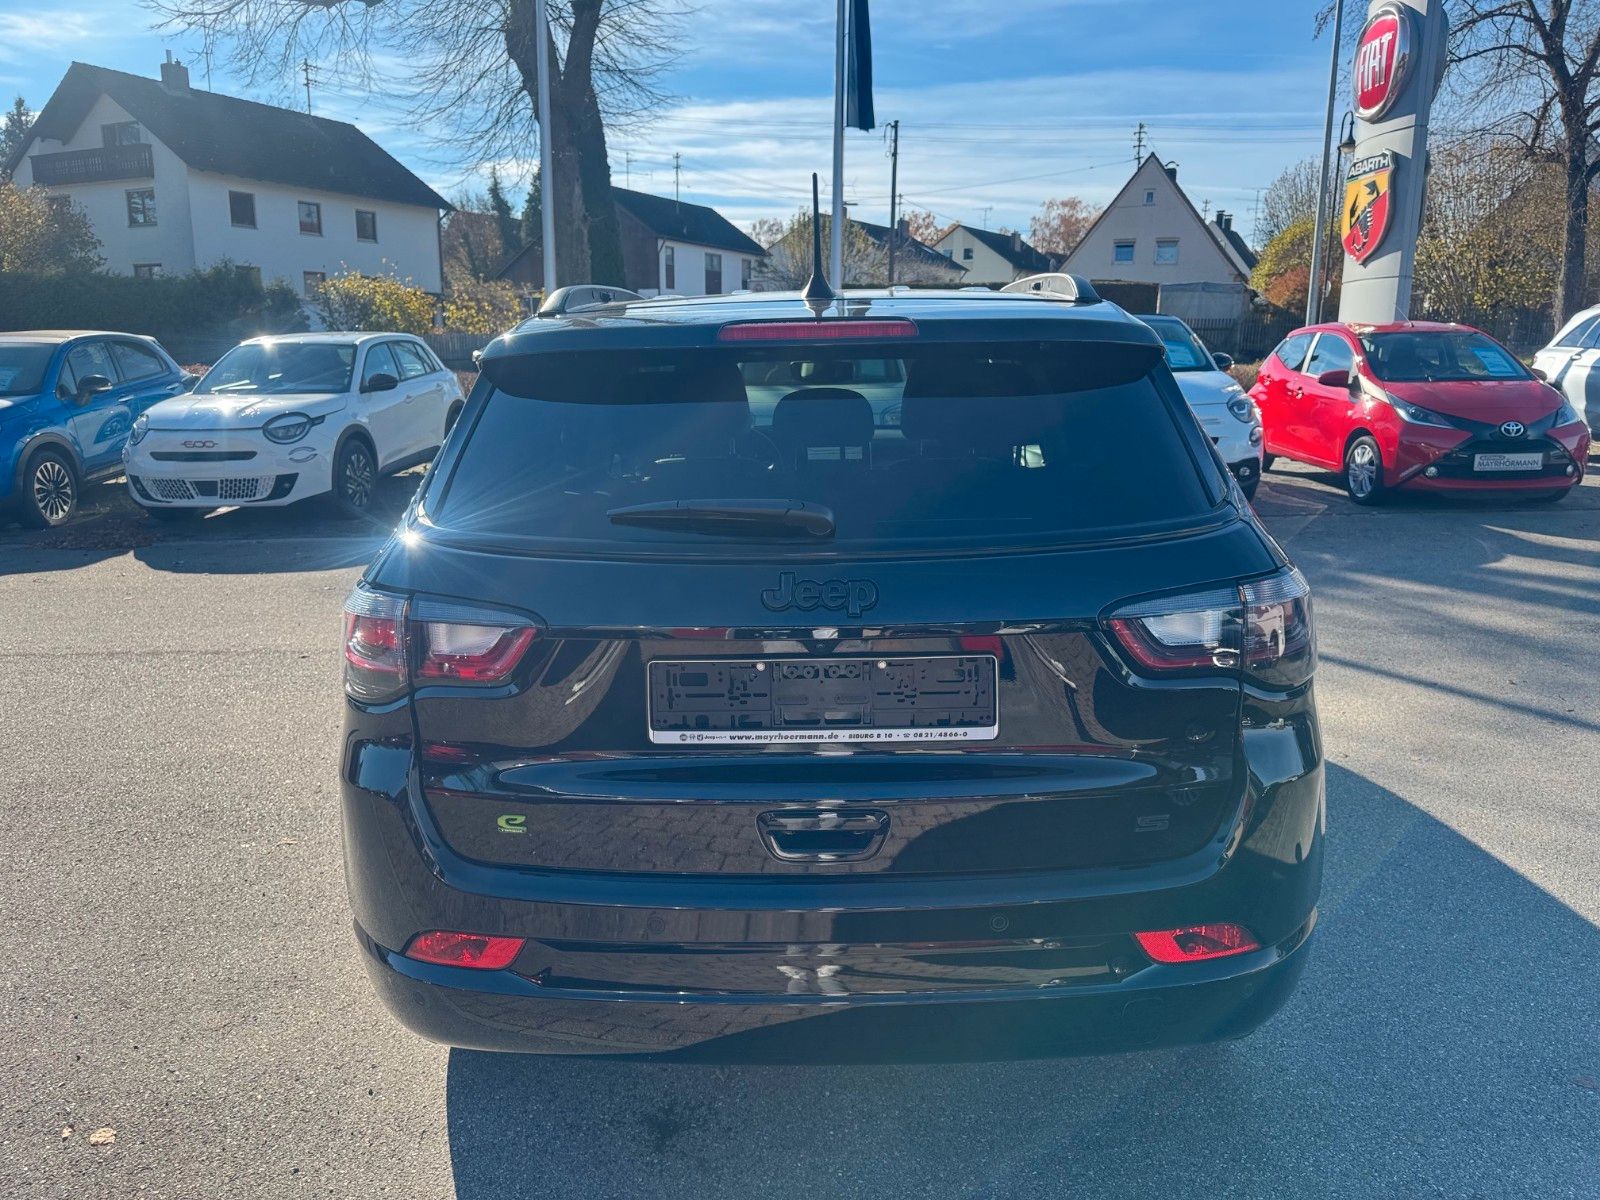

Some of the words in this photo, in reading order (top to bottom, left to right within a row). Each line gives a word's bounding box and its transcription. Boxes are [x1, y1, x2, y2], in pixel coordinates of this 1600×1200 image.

[1358, 31, 1394, 95] FIAT
[1349, 155, 1389, 177] ABARTH
[760, 571, 880, 618] Jeep
[729, 732, 839, 742] www.mayrhoermann.de
